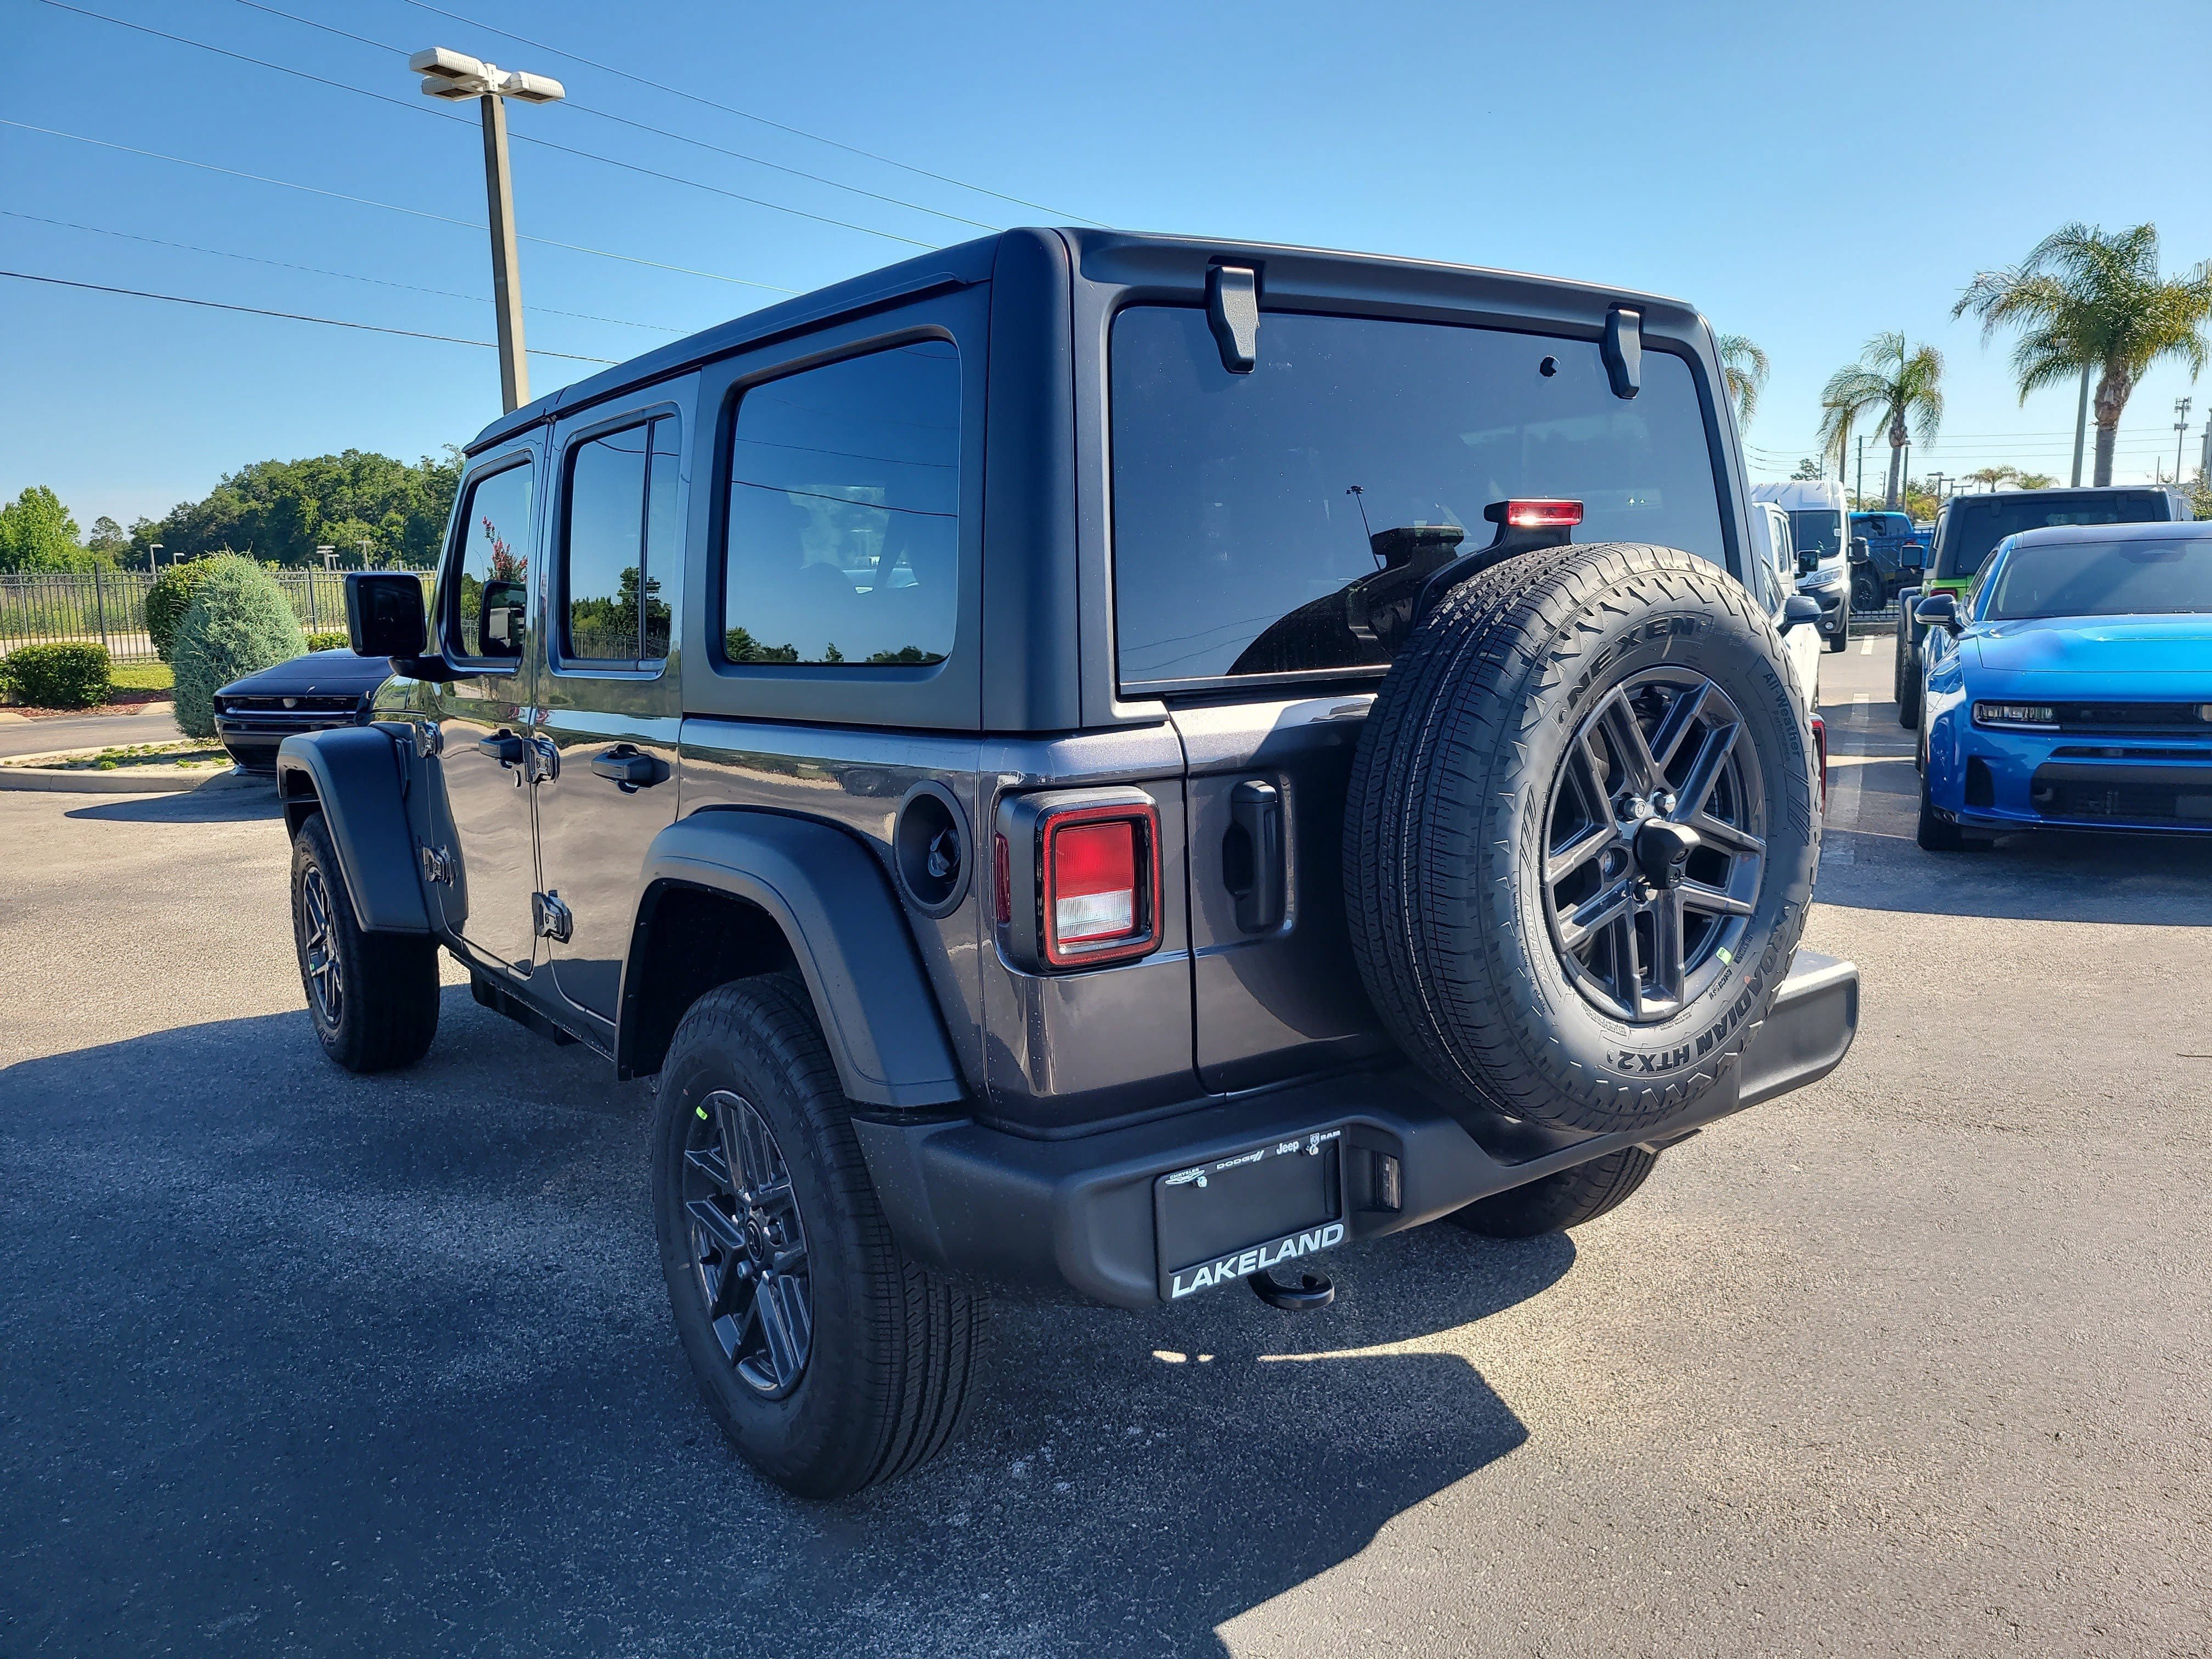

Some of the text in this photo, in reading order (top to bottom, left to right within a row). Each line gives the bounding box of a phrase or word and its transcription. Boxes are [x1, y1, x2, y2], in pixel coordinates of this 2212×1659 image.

[1567, 616, 1696, 710] NEXEN
[1763, 672, 1801, 757] All-Weather
[1695, 927, 1786, 1057] ROADIAN
[1618, 1043, 1690, 1073] HTX2
[1169, 1130, 1341, 1180] CHRYSLER DODGE Jeep RAM
[1171, 1223, 1345, 1299] LAKELAND
